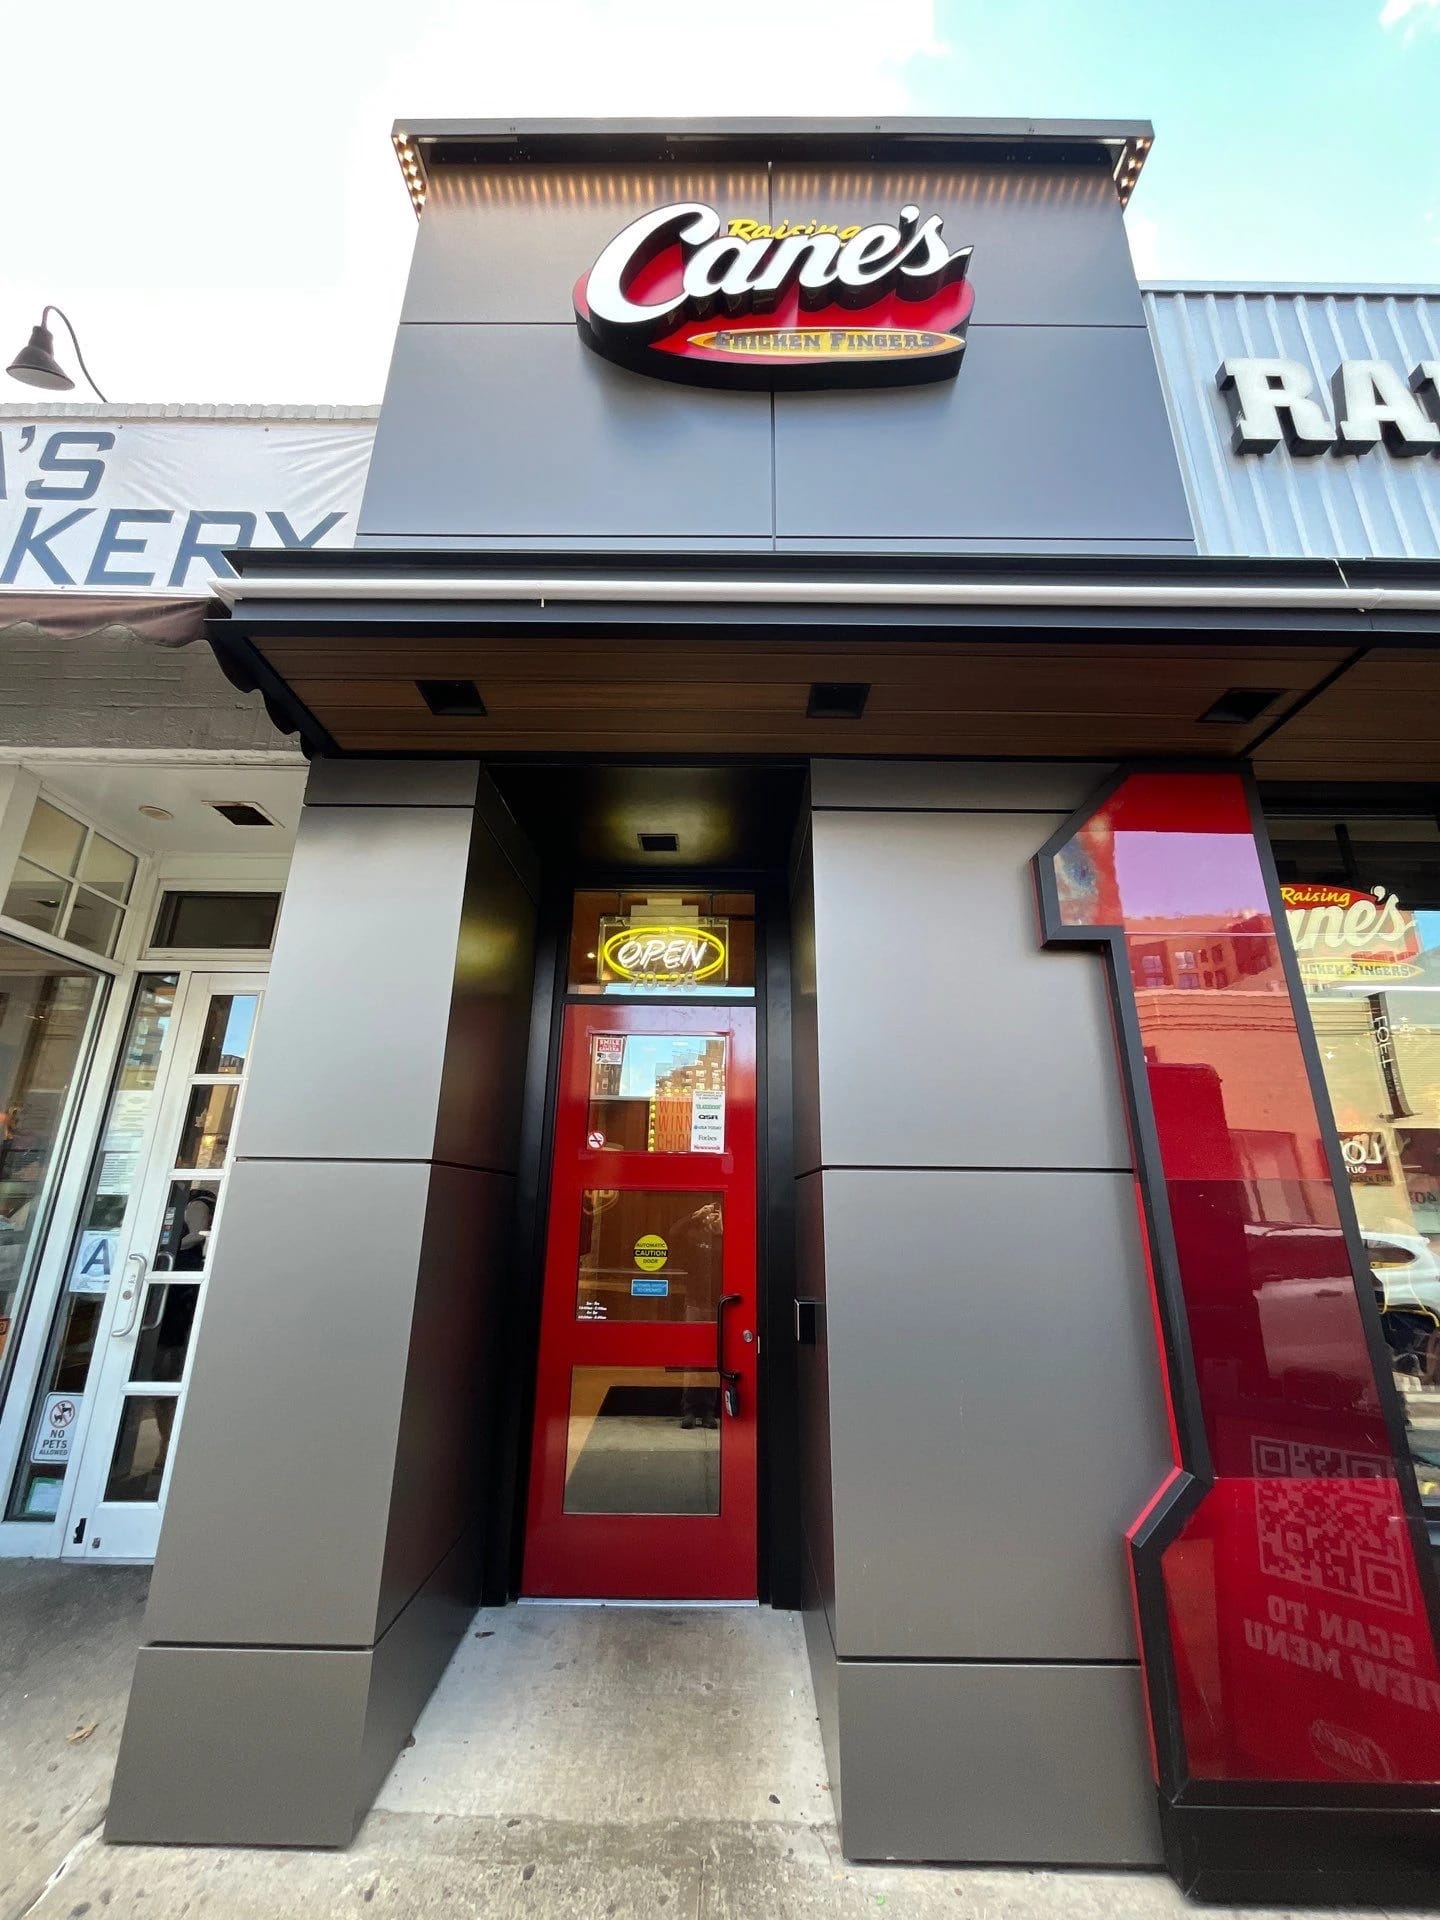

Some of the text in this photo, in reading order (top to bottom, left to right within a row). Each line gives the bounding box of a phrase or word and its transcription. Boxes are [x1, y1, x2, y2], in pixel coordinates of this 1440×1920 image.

[728, 219, 862, 247] Raising
[586, 201, 973, 323] Cane's
[830, 331, 934, 350] FINGERS
[0, 425, 116, 501] 'S
[1280, 887, 1351, 908] Raising
[617, 939, 707, 969] OPEN
[1350, 962, 1410, 977] FINGERS
[80, 1238, 111, 1275] A
[42, 1439, 67, 1449] PETS
[50, 1429, 65, 1438] NO
